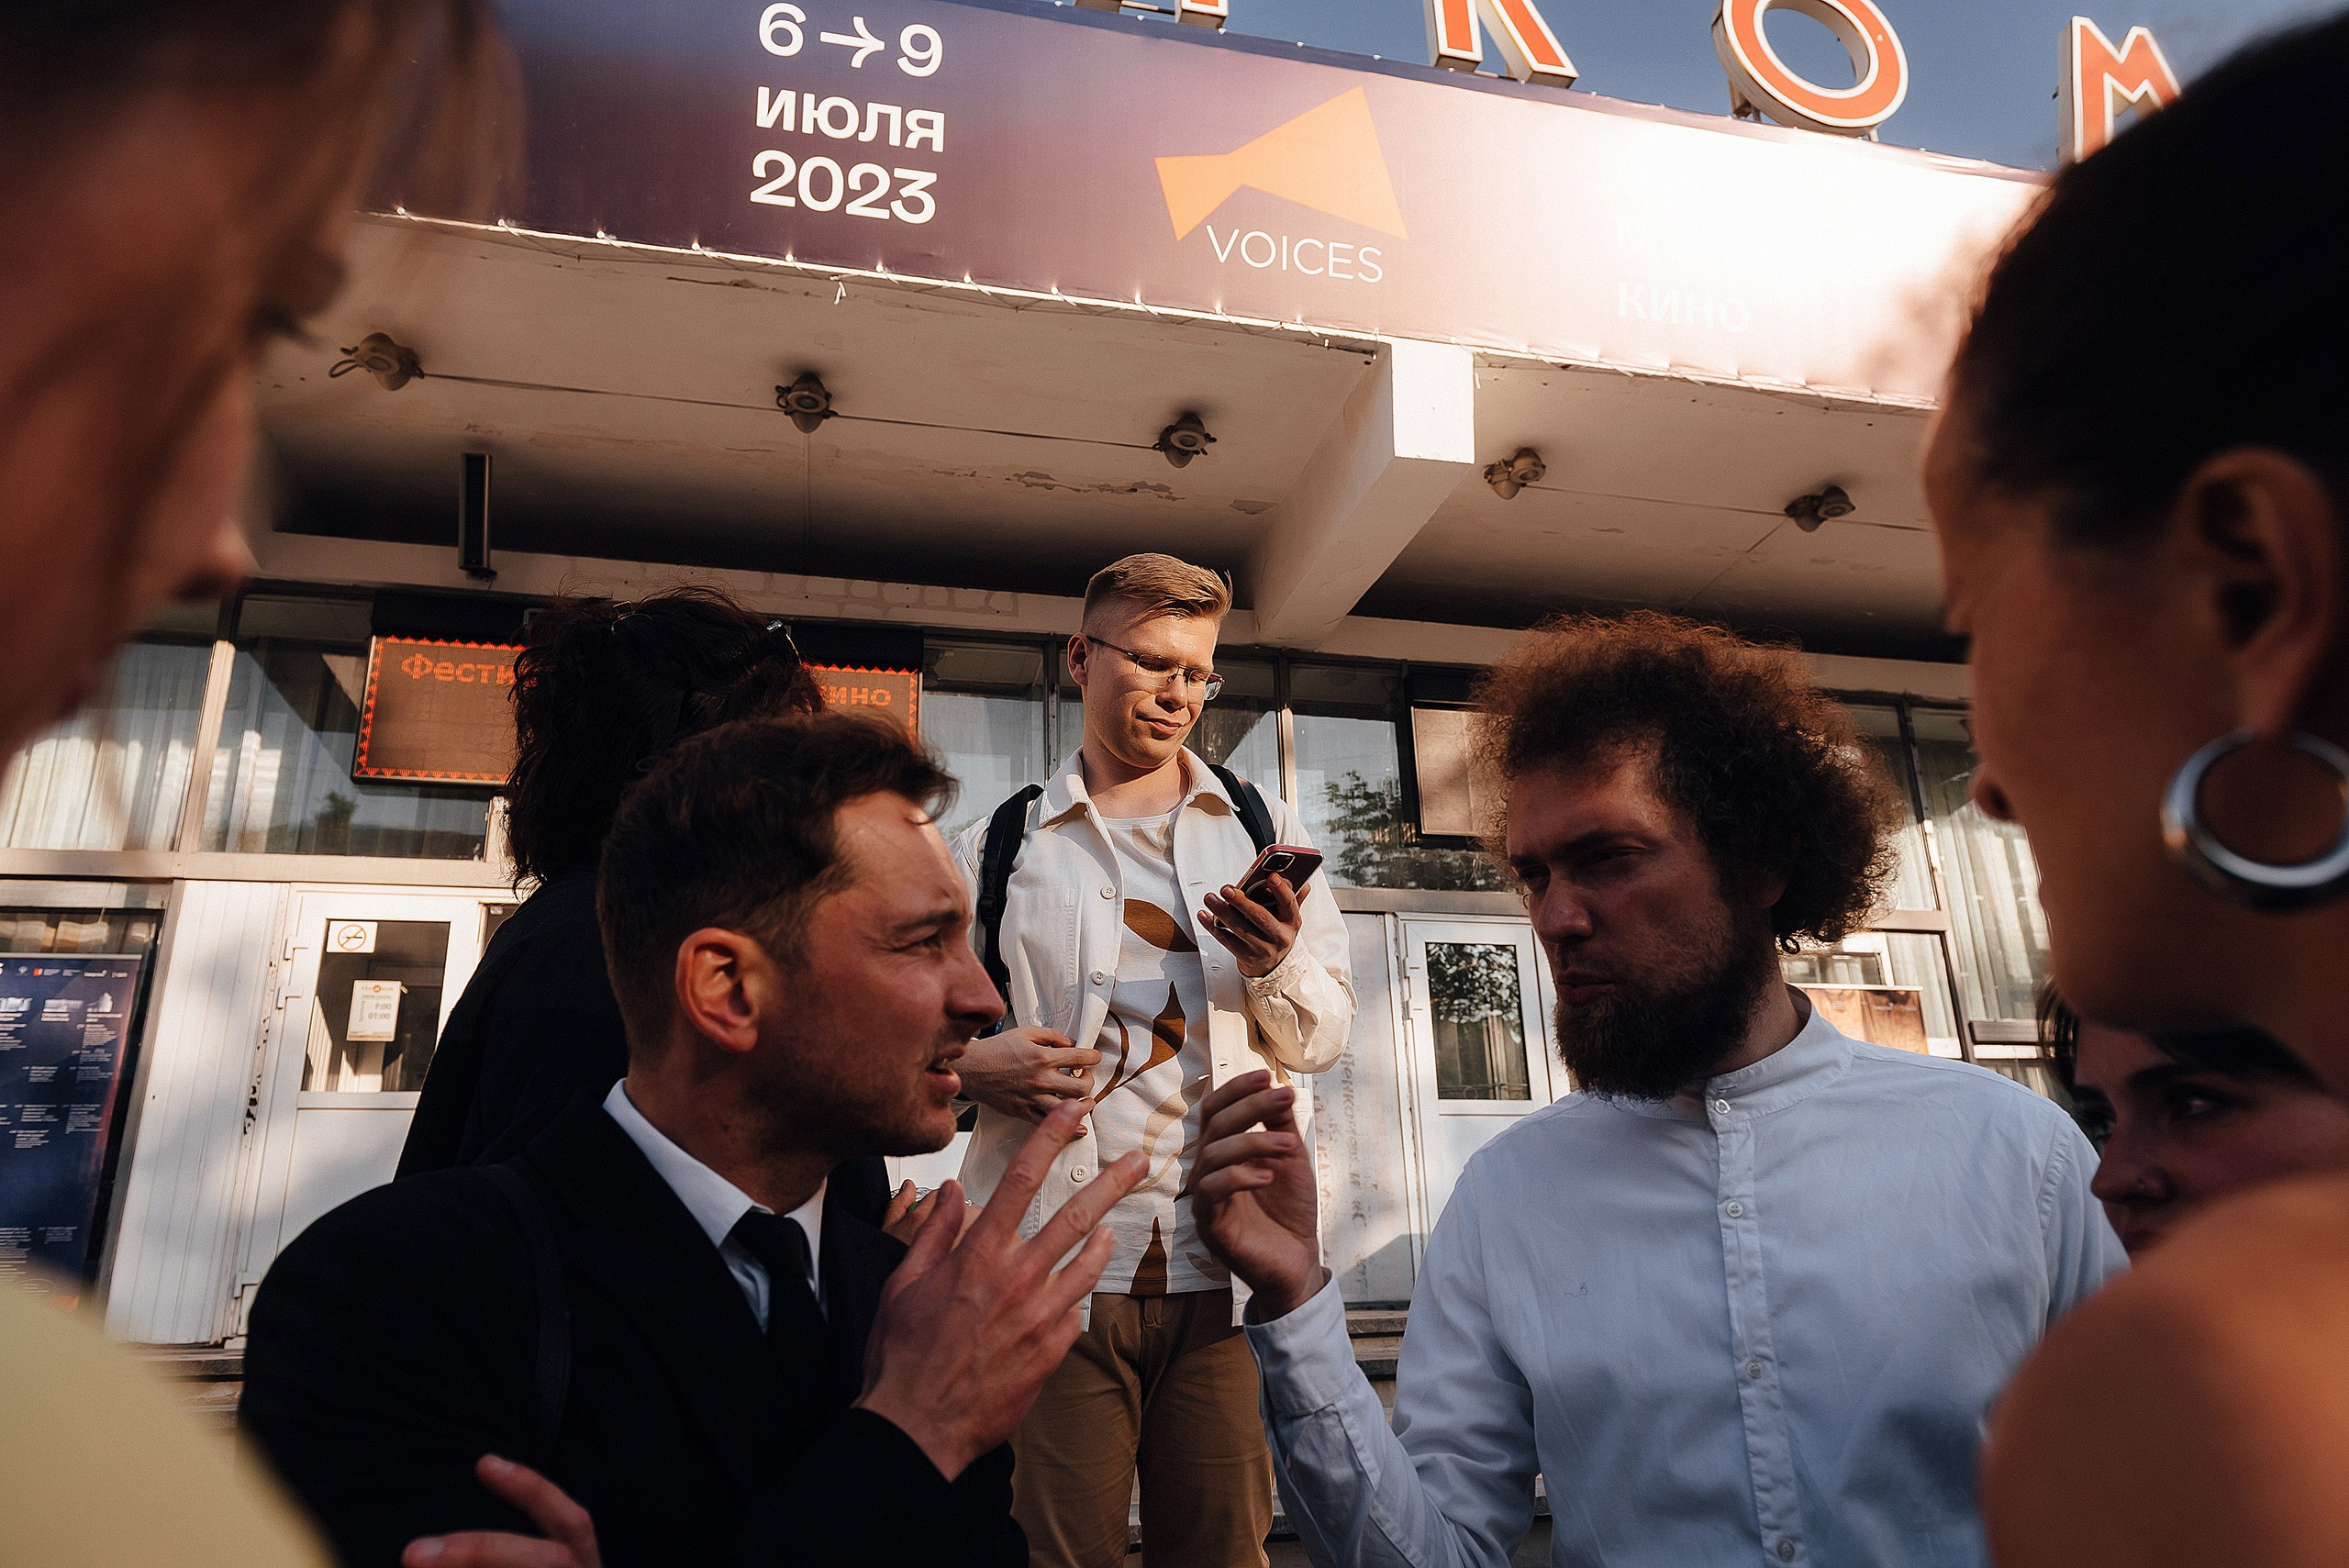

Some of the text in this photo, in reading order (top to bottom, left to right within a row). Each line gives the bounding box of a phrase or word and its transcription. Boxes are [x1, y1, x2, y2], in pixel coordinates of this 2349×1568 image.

[759, 3, 943, 77] 6 9
[750, 150, 936, 224] 2023
[1206, 224, 1384, 284] VOICES
[401, 652, 519, 684] Фести
